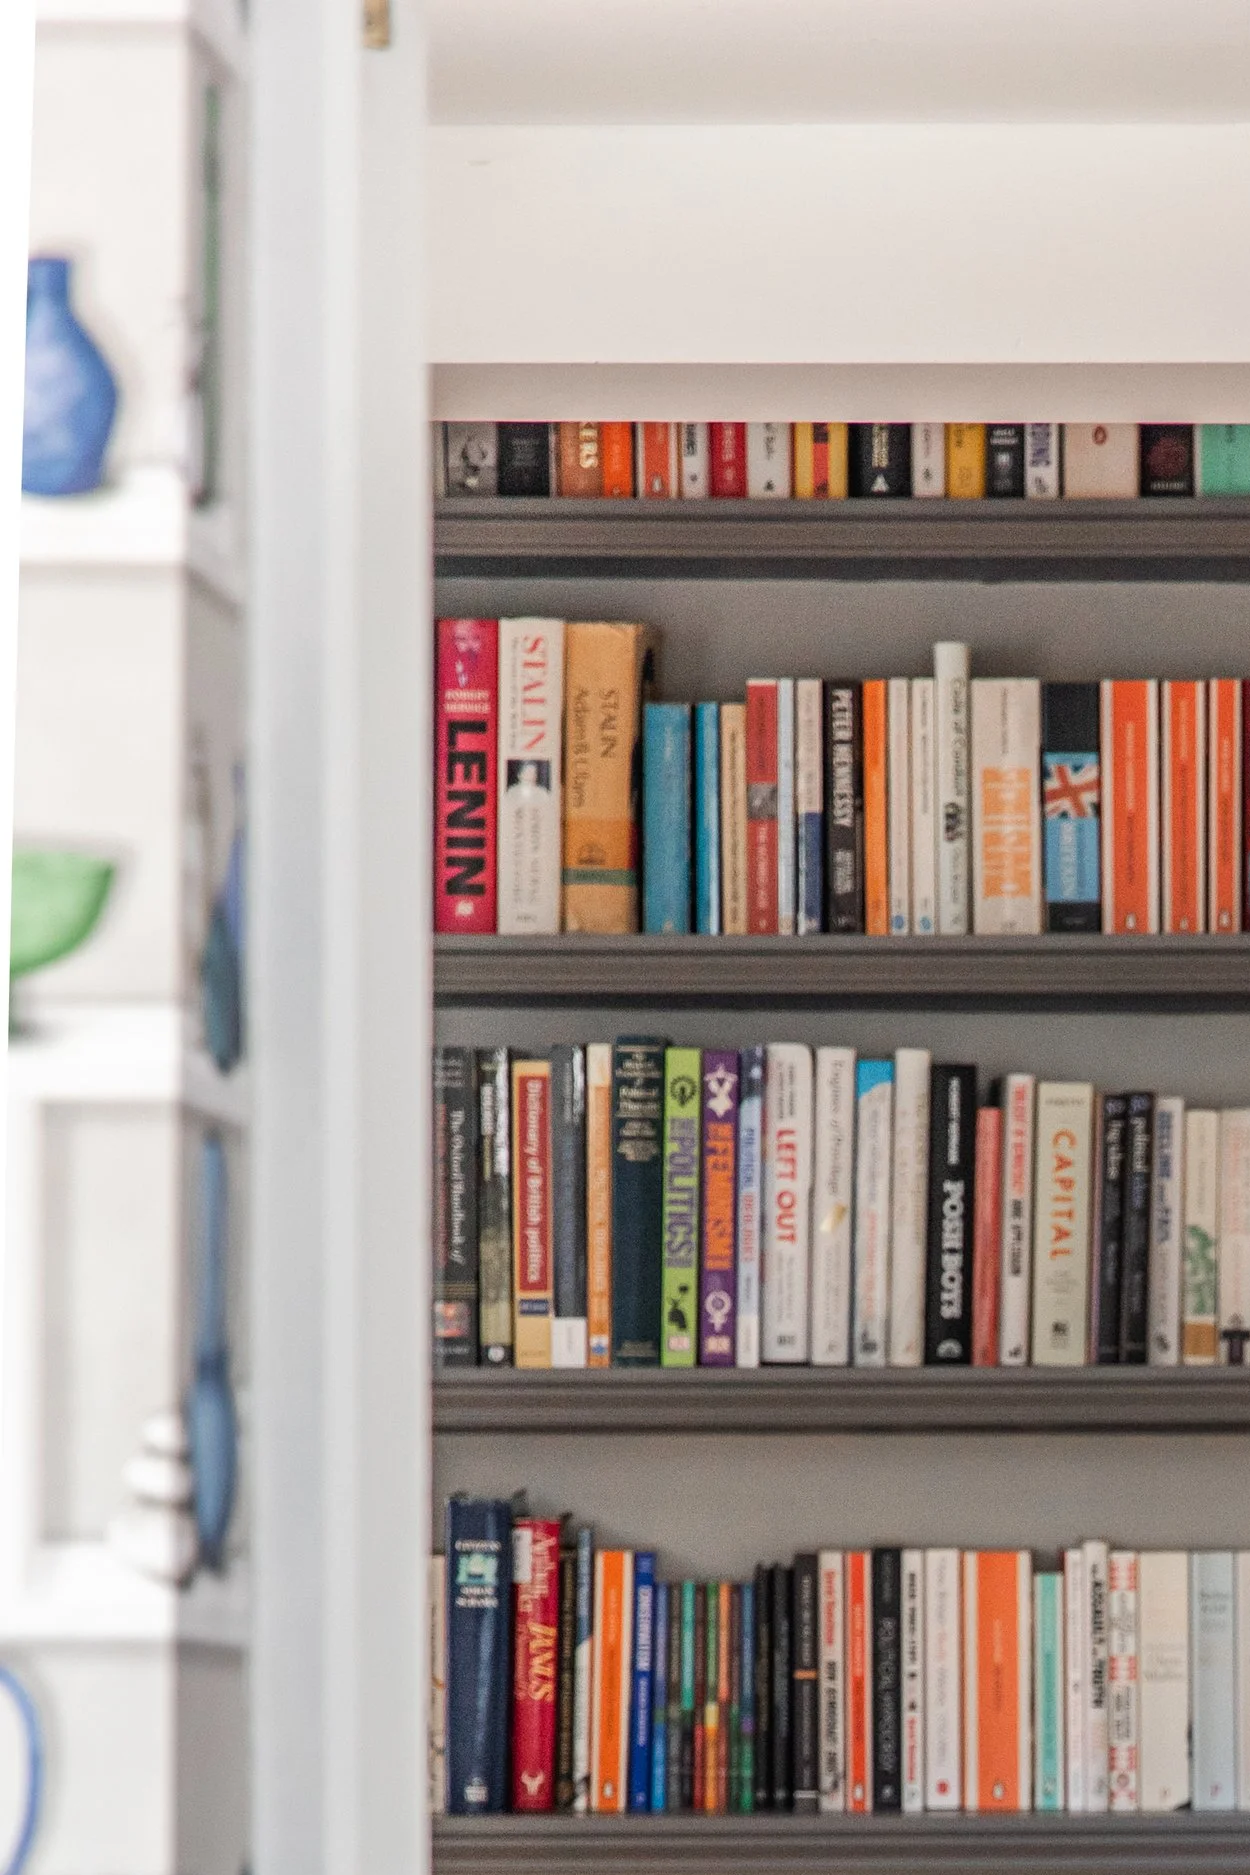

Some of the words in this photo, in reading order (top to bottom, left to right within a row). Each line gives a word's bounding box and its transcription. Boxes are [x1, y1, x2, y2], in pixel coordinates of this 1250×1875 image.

[522, 635, 548, 752] STALIN
[601, 689, 617, 757] STALIN
[833, 689, 852, 740] PETER
[833, 745, 853, 827] HENNESSY
[952, 739, 965, 796] Conduct
[446, 720, 487, 895] LENIN
[525, 1081, 541, 1154] Dictionary
[829, 1061, 842, 1113] Engines
[451, 1110, 464, 1132] The
[1131, 1117, 1148, 1173] political
[1158, 1111, 1172, 1180] DECLINE
[527, 1159, 541, 1173] of
[742, 1127, 755, 1190] POLITICAL
[776, 1128, 796, 1181] LEFT
[451, 1181, 465, 1245] Handbook
[527, 1177, 541, 1225] British
[667, 1136, 696, 1256] POLITICS
[706, 1139, 732, 1257] FEMINISM
[776, 1190, 796, 1243] OUT
[941, 1180, 963, 1248] POSH
[1050, 1129, 1076, 1261] CAPITAL
[526, 1229, 540, 1282] politics
[941, 1254, 962, 1319] BOYS
[529, 1623, 556, 1702] JANUS
[879, 1617, 893, 1692] POLITICAL
